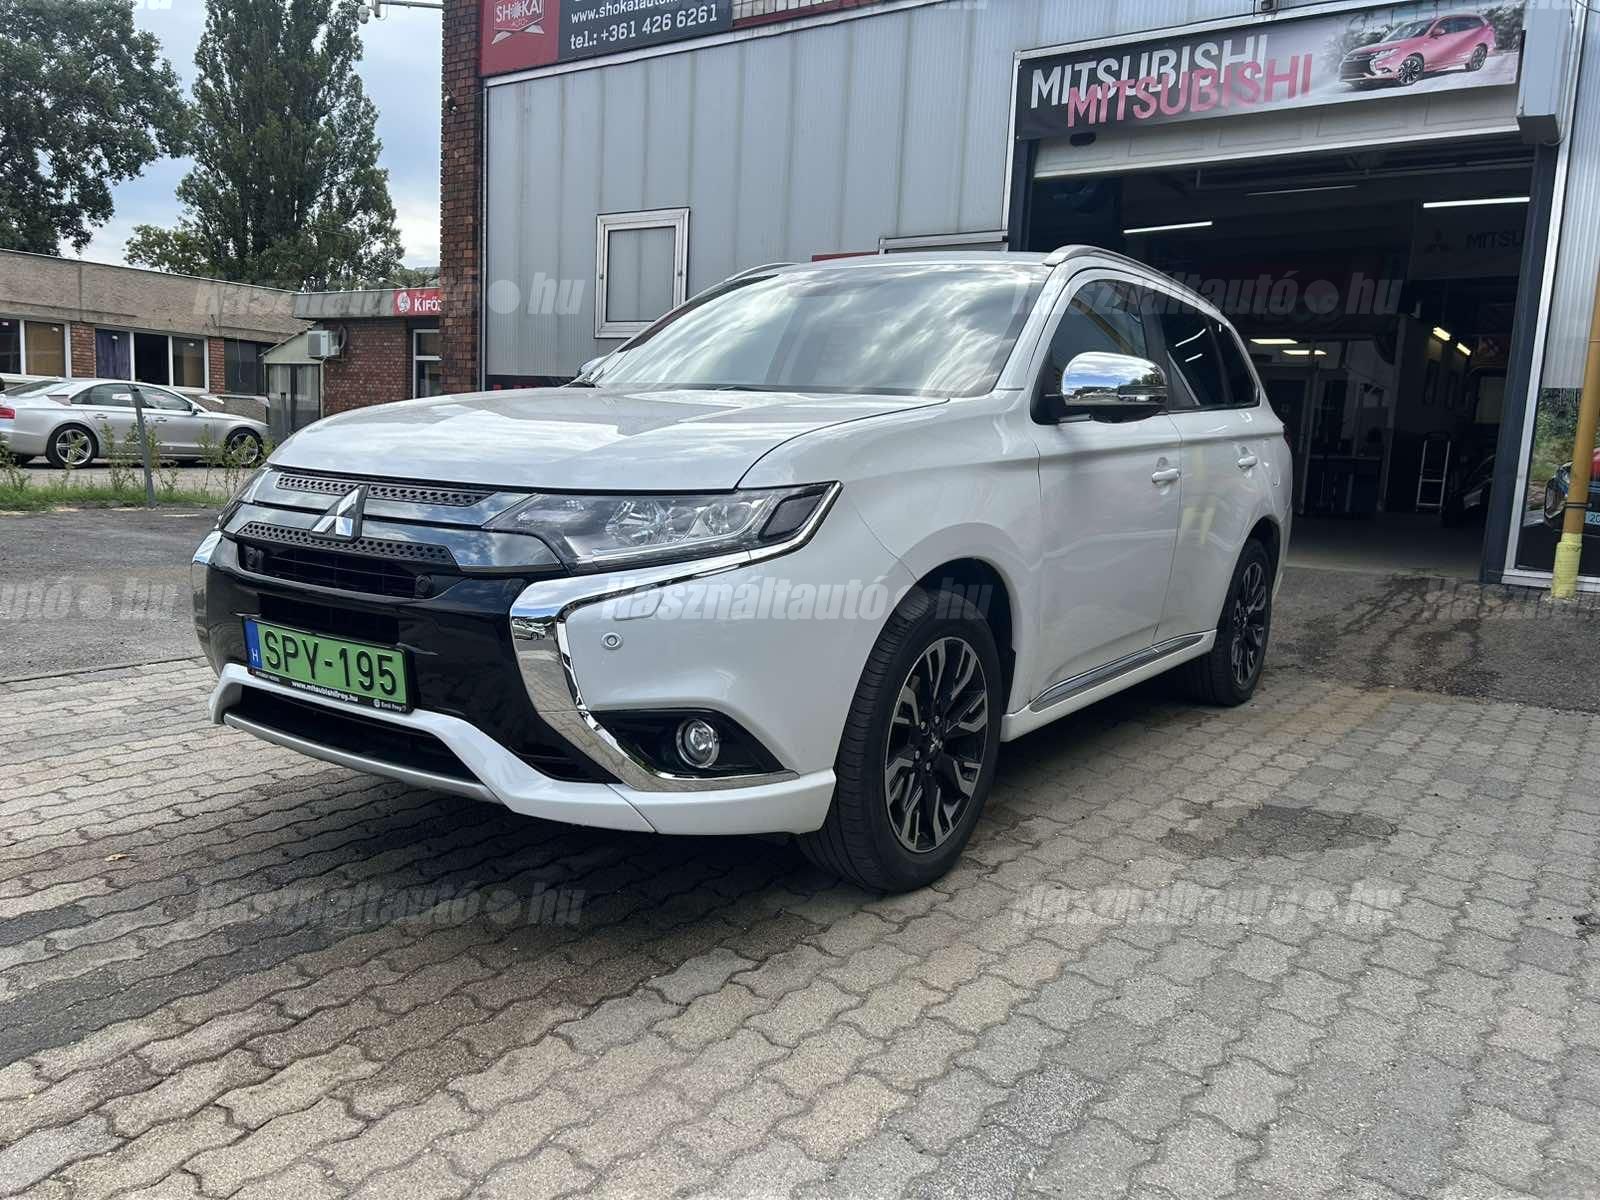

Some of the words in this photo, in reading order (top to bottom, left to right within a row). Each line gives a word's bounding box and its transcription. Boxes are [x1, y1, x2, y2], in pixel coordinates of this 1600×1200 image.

[570, 30, 598, 49] tel.:
[600, 20, 637, 42] +361
[641, 13, 672, 34] 426
[676, 3, 718, 28] 6261
[1031, 34, 1268, 108] MITSUBISHI
[1067, 53, 1313, 128] MITSUBISHI
[251, 648, 259, 663] H
[264, 629, 397, 696] SPY-195
